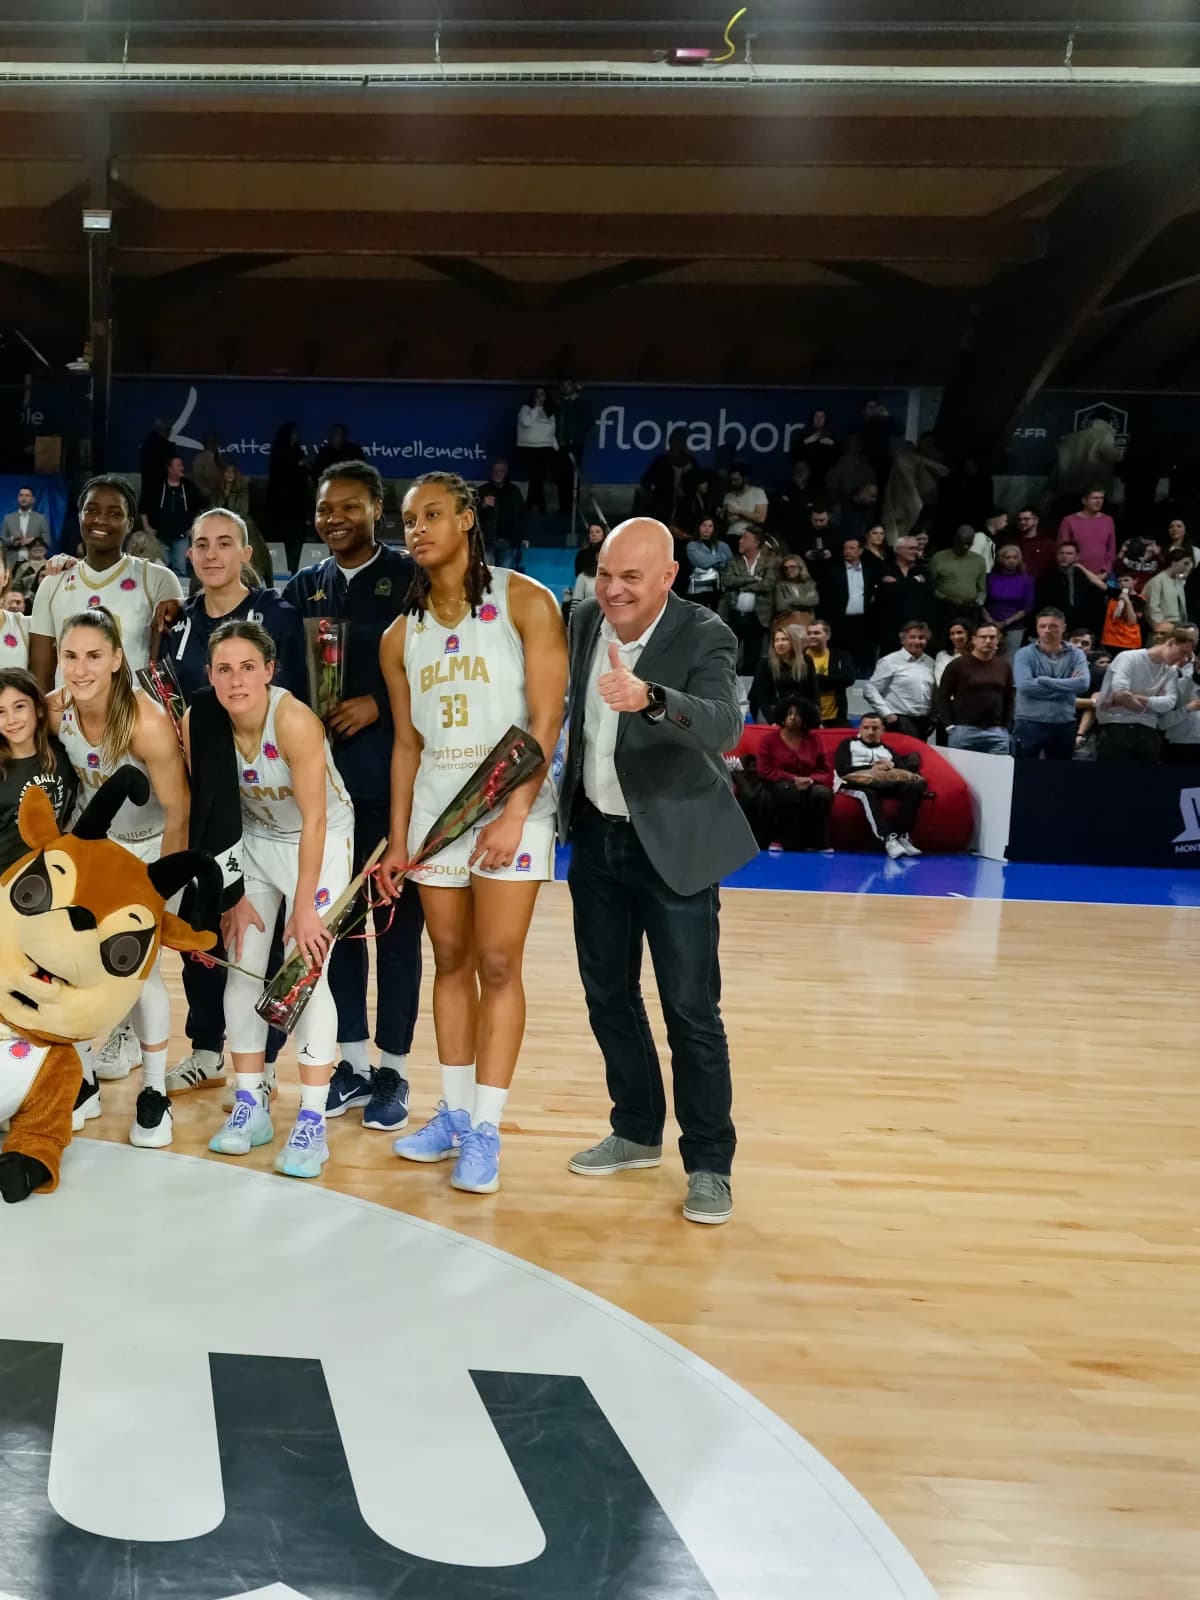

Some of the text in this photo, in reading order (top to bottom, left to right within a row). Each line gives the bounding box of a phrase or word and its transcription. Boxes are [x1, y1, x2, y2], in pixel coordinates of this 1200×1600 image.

[360, 440, 488, 460] aturellement.
[419, 655, 490, 693] BLMA
[439, 693, 469, 728] 33
[33, 774, 56, 786] BALL
